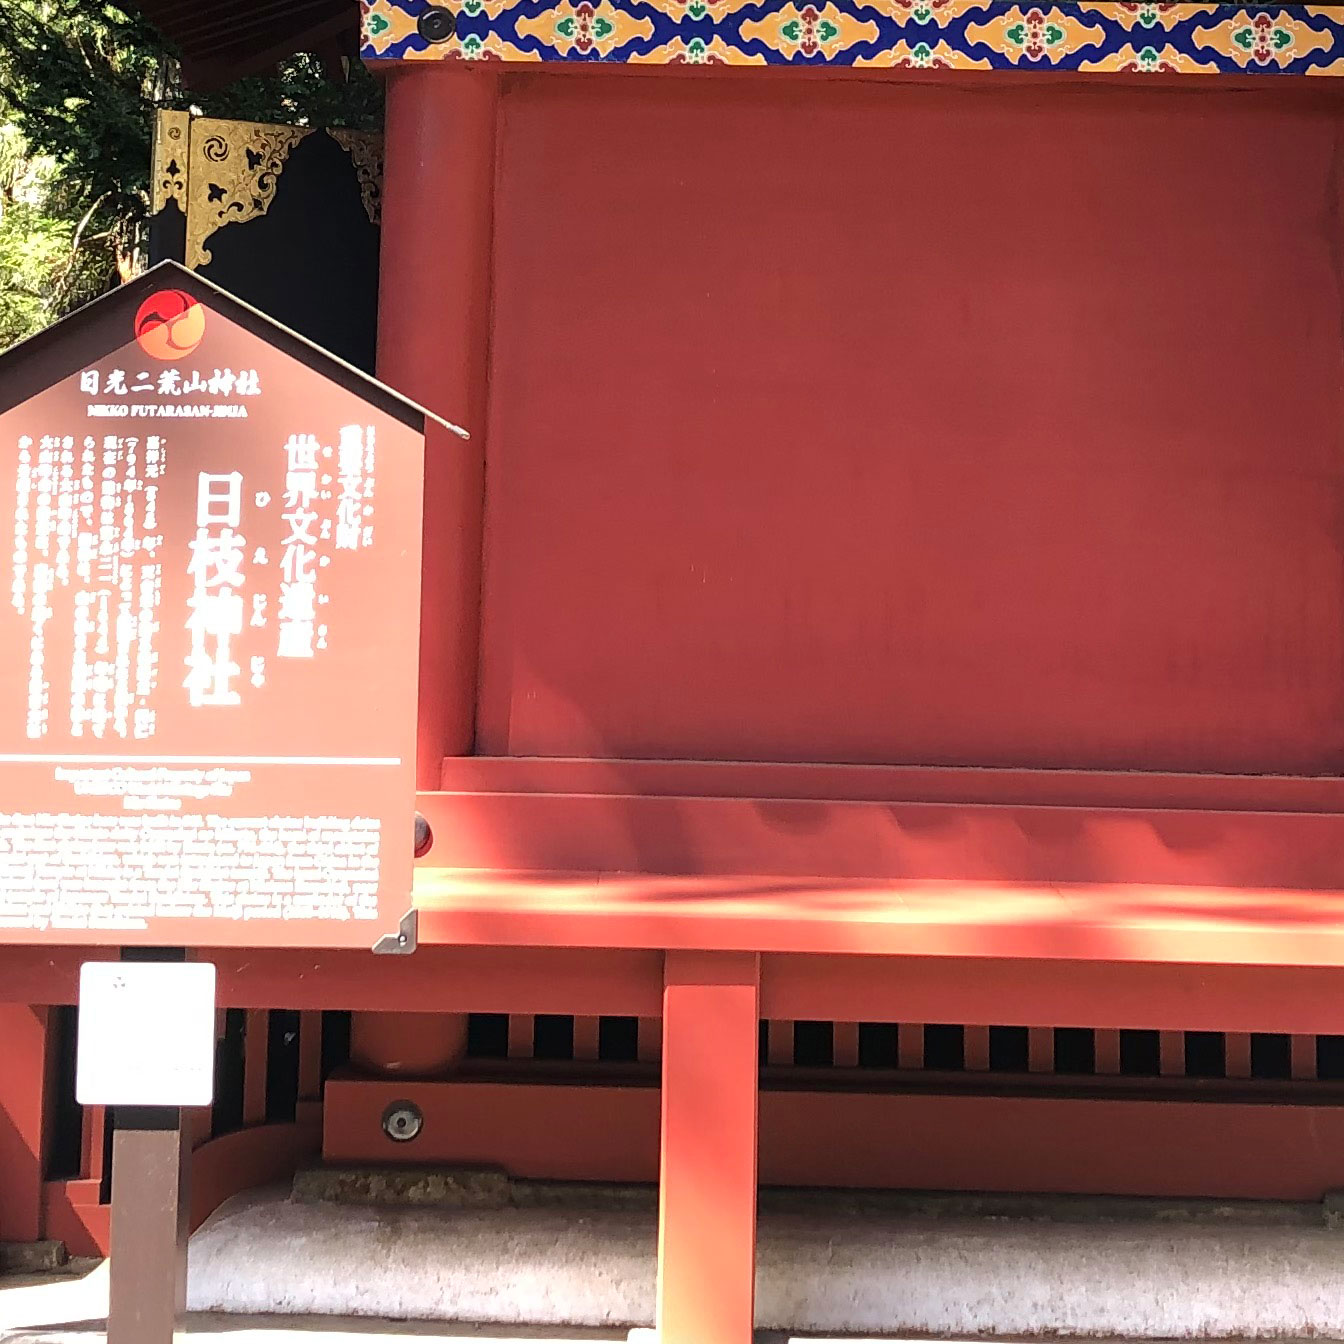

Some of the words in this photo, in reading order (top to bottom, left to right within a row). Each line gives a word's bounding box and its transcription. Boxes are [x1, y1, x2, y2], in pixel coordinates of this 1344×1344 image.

[80, 368, 262, 396] 日光二荒山神社
[87, 405, 129, 417] NIKKO
[182, 471, 246, 706] 日枝神社
